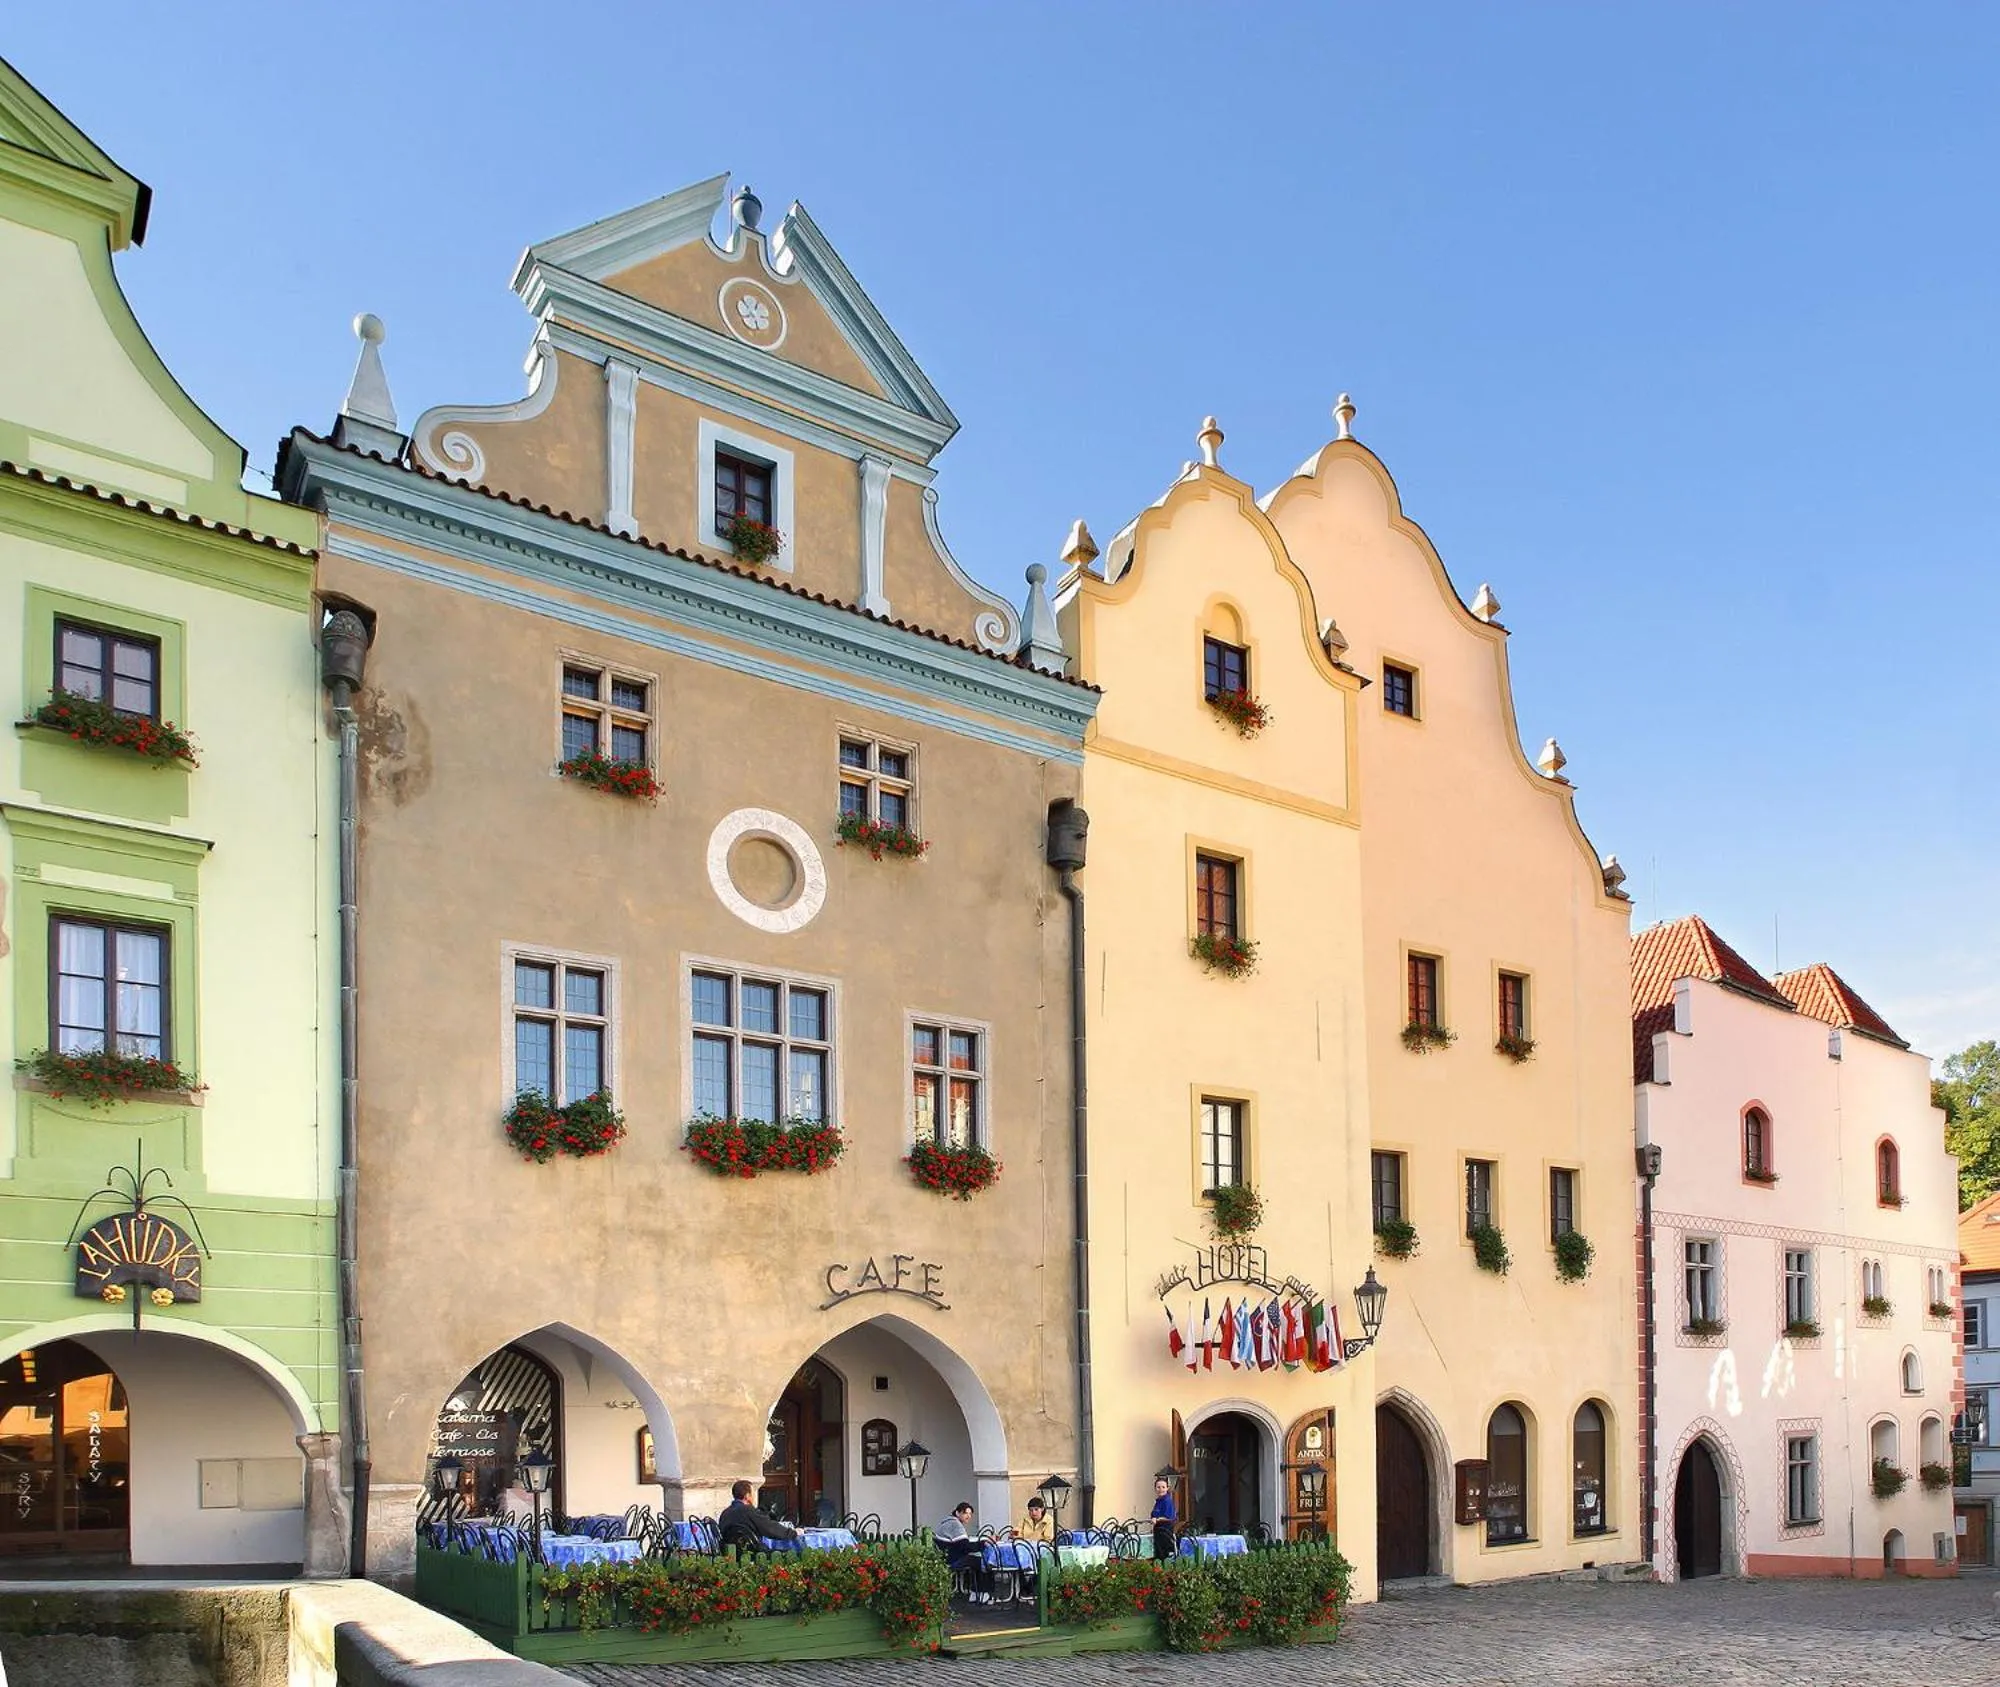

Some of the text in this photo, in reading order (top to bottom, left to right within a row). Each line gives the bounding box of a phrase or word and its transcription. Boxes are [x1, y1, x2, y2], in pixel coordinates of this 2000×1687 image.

[79, 1213, 200, 1288] LAHŮDKY
[1197, 1244, 1277, 1288] HOTEL
[827, 1254, 944, 1298] CAFE
